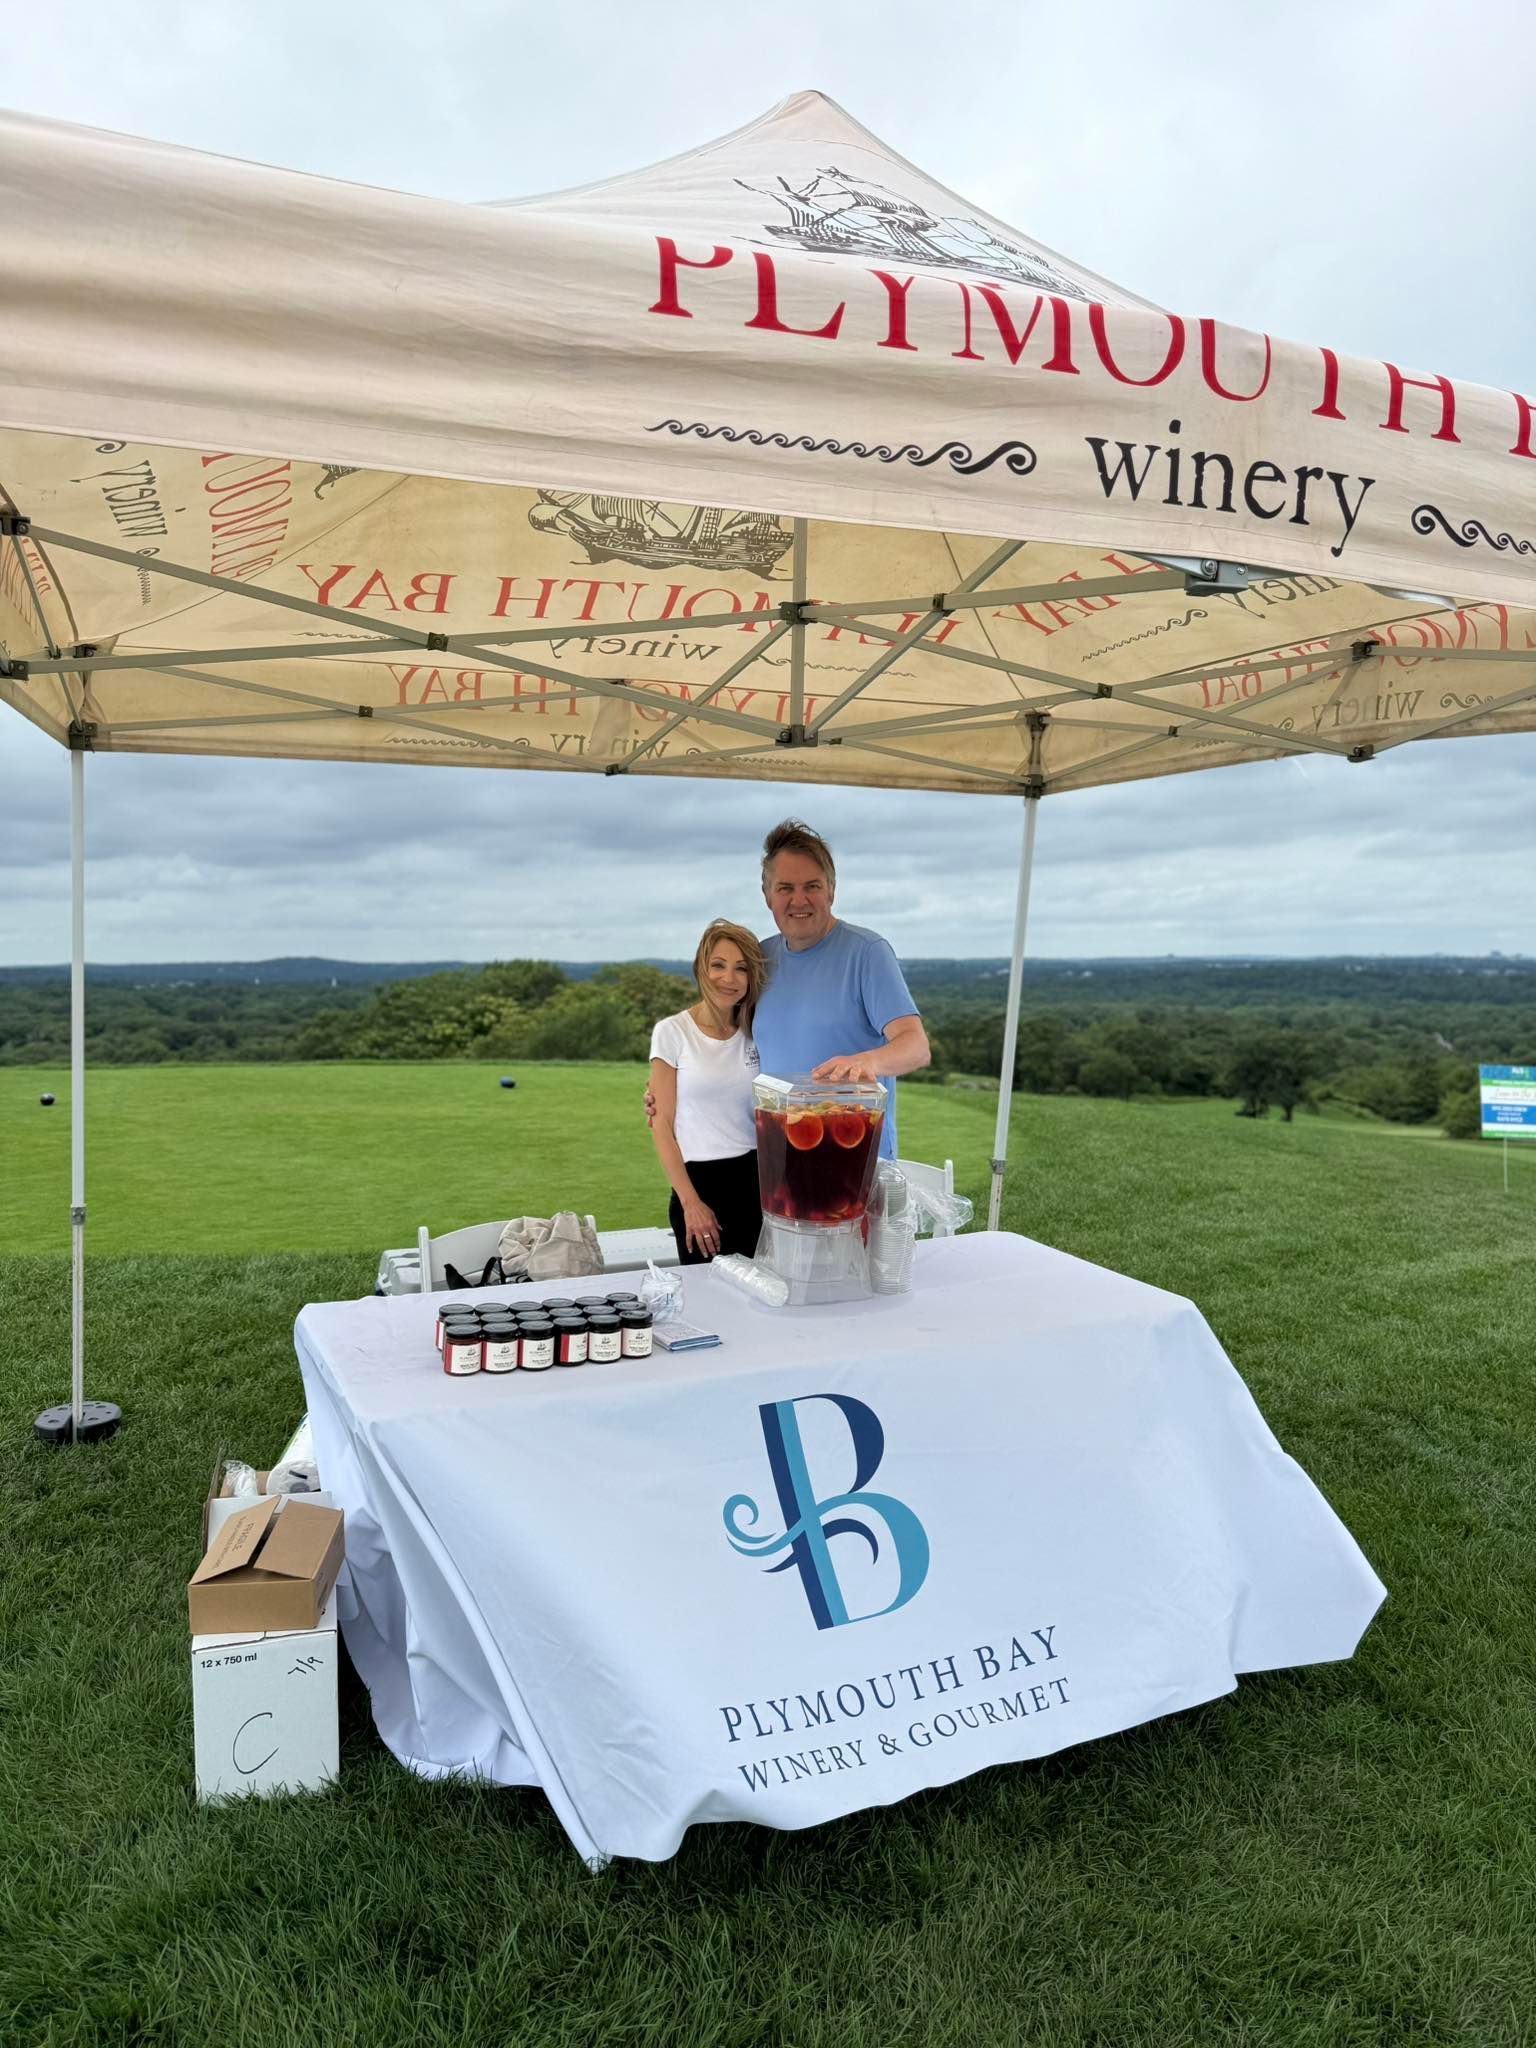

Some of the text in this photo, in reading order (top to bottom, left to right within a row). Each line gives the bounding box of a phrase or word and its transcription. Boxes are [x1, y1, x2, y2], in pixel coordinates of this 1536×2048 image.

[1085, 419, 1376, 558] winery
[201, 1653, 258, 1668] 12 x 750 ml
[719, 1625, 1059, 1743] PLYMOUTH BAY
[738, 1677, 1072, 1793] WINERY & GOURMET
